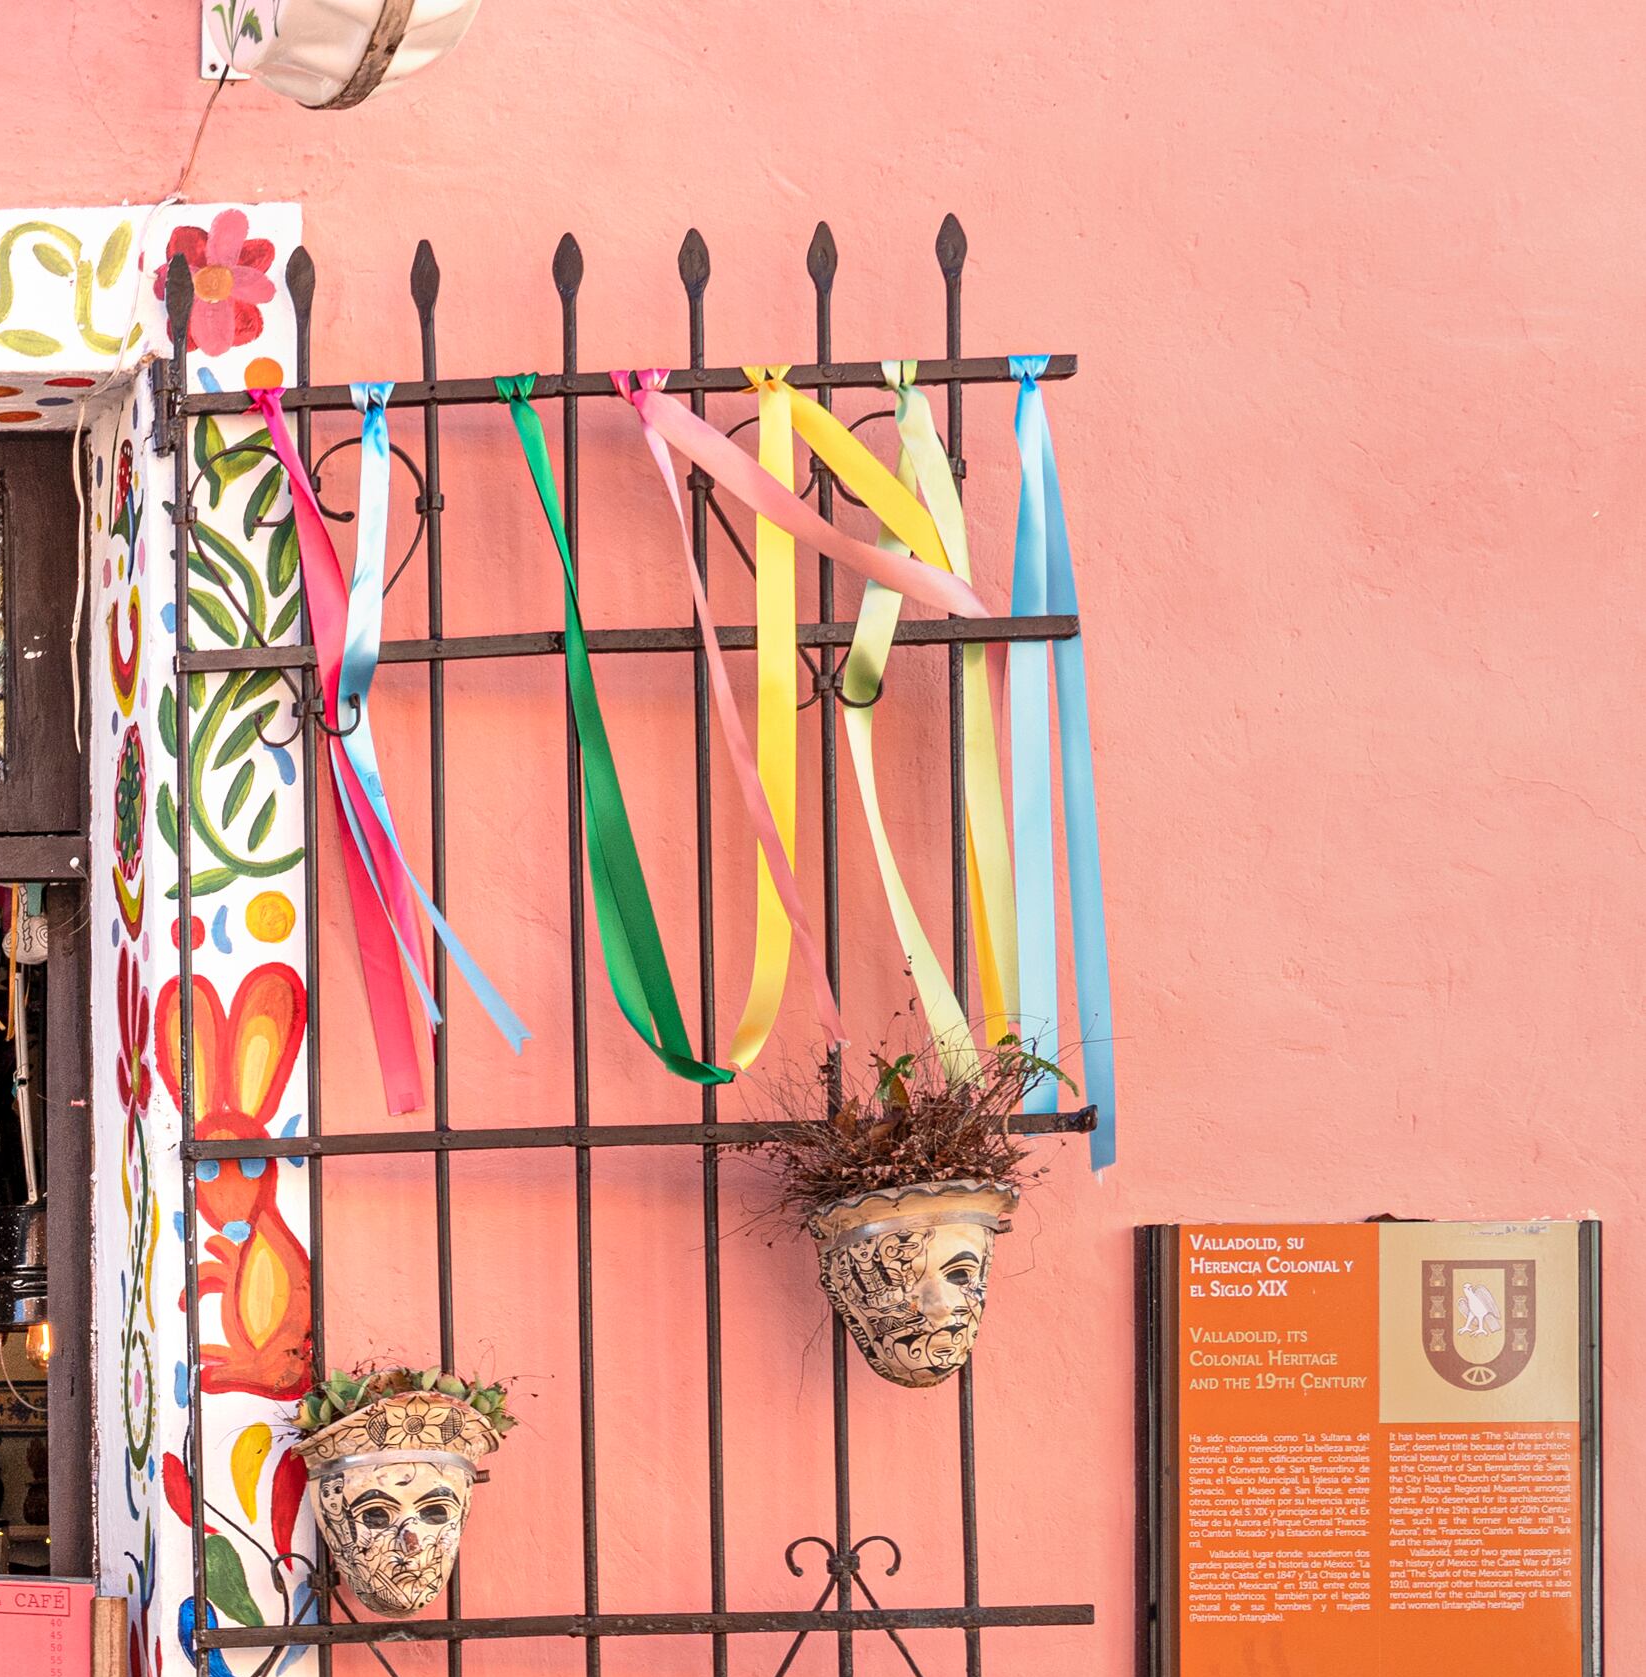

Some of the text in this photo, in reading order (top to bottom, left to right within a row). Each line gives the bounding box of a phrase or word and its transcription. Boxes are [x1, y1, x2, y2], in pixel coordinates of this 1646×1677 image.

[1257, 1280, 1287, 1296] XIX
[1189, 1454, 1228, 1464] tectónica
[1268, 1454, 1323, 1464] edificaciones
[1328, 1454, 1371, 1464] coloniales
[1389, 1453, 1418, 1463] tonical
[1419, 1452, 1449, 1465] beauty
[1461, 1452, 1472, 1462] its
[1473, 1452, 1507, 1462] colonial
[1551, 1452, 1571, 1462] such
[1188, 1467, 1214, 1475] como
[1229, 1465, 1271, 1475] Convento
[1289, 1465, 1305, 1475] San
[1309, 1465, 1355, 1475] Bernardino
[1225, 1475, 1256, 1485] Palacio
[1312, 1475, 1339, 1488] Iglesia
[1354, 1475, 1370, 1485] San
[1388, 1474, 1404, 1484] the
[1404, 1474, 1421, 1486] City
[1442, 1473, 1457, 1483] the
[1457, 1473, 1490, 1483] Church
[1500, 1473, 1517, 1483] San
[1517, 1473, 1554, 1483] Servacio
[1554, 1473, 1571, 1483] and
[1247, 1486, 1276, 1496] Museo
[1294, 1486, 1311, 1496] San
[1347, 1486, 1370, 1496] entre
[1389, 1484, 1404, 1494] the
[1405, 1484, 1422, 1494] San
[1424, 1484, 1452, 1497] Roque
[1454, 1484, 1491, 1496] Regional
[1534, 1483, 1571, 1496] amongst
[1389, 1505, 1424, 1518] heritage
[1435, 1505, 1450, 1515] the
[1452, 1505, 1470, 1515] 19th
[1471, 1505, 1488, 1515] and
[1489, 1505, 1508, 1515] start
[1520, 1505, 1540, 1515] 20th
[1541, 1505, 1570, 1515] Centu-
[1389, 1537, 1406, 1547] and
[1406, 1537, 1422, 1547] the
[1422, 1537, 1453, 1550] railway
[1252, 1549, 1274, 1562] lugar
[1275, 1549, 1304, 1559] donde
[1307, 1549, 1353, 1559] sucedieron
[1354, 1549, 1370, 1559] dos
[15, 1591, 65, 1609] CAFÉ
[50, 1656, 63, 1664] 55
[50, 1669, 63, 1677] 55
